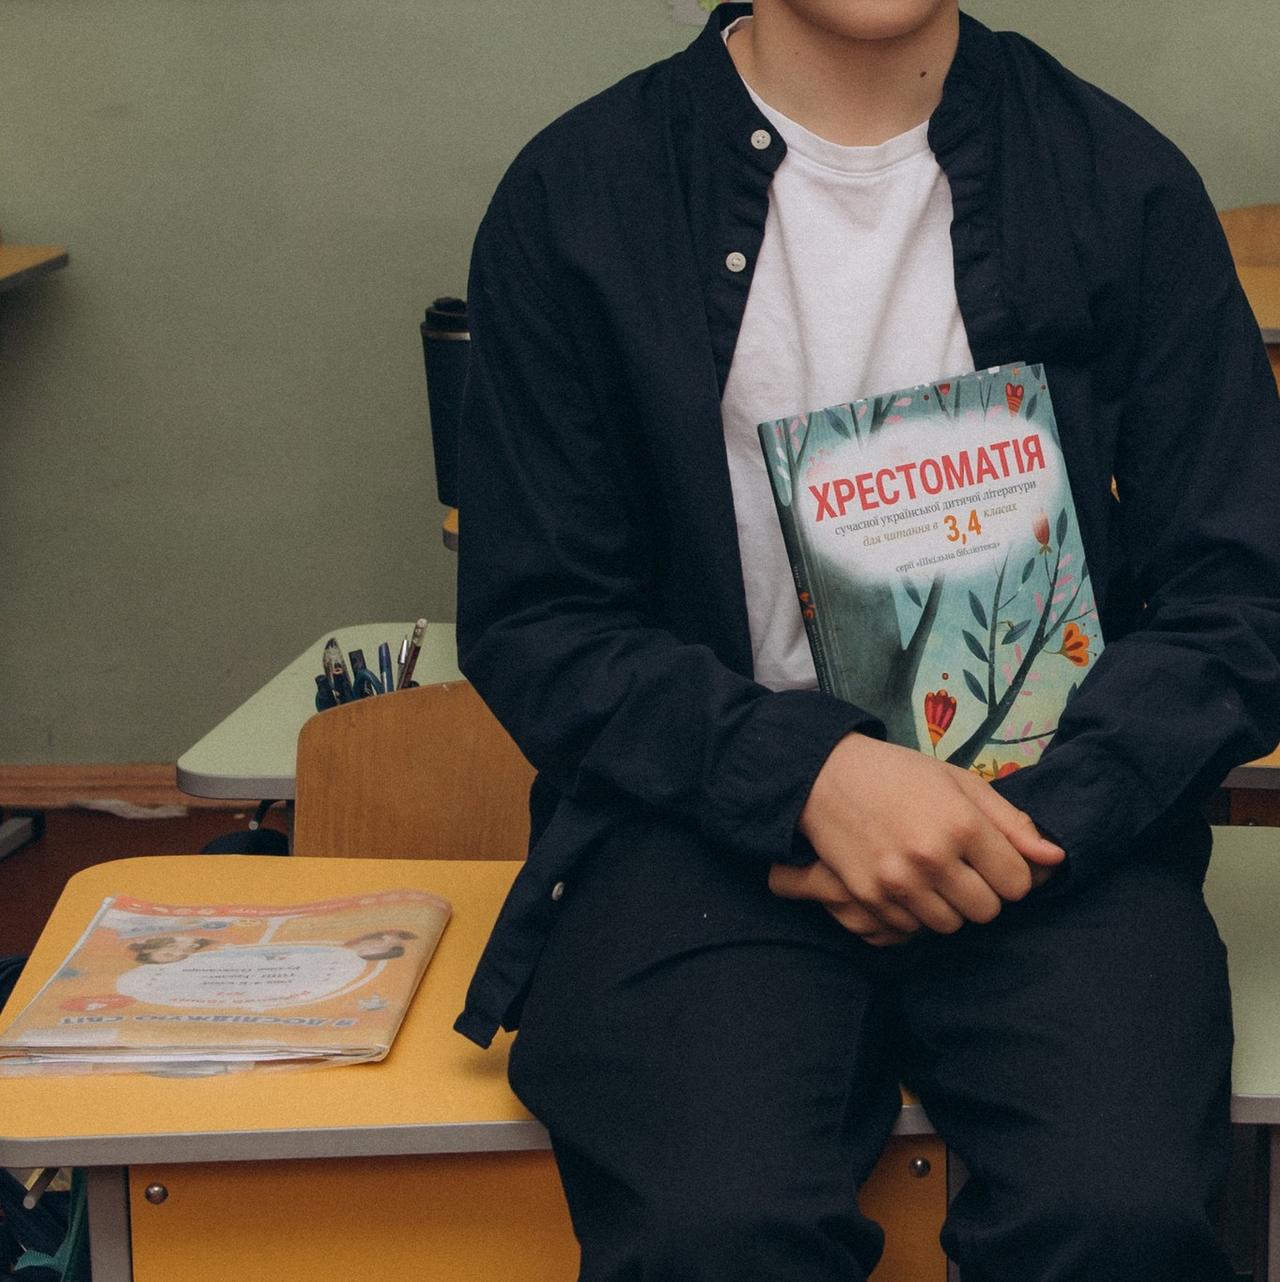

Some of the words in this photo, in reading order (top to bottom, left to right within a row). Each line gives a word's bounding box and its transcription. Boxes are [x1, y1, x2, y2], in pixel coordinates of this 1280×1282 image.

[808, 434, 1047, 522] ХРЕСТОМАТІЯ
[834, 518, 879, 536] сучасної
[880, 501, 941, 528] української
[941, 492, 981, 511] дитячої
[982, 479, 1037, 502] літератури
[862, 534, 882, 547] для
[883, 523, 931, 542] читання
[931, 521, 939, 531] в
[943, 509, 982, 544] 3,4
[983, 502, 1018, 518] класах
[895, 561, 914, 573] серії
[915, 551, 956, 568] «Шкільна
[956, 542, 1001, 559] бібліотека»
